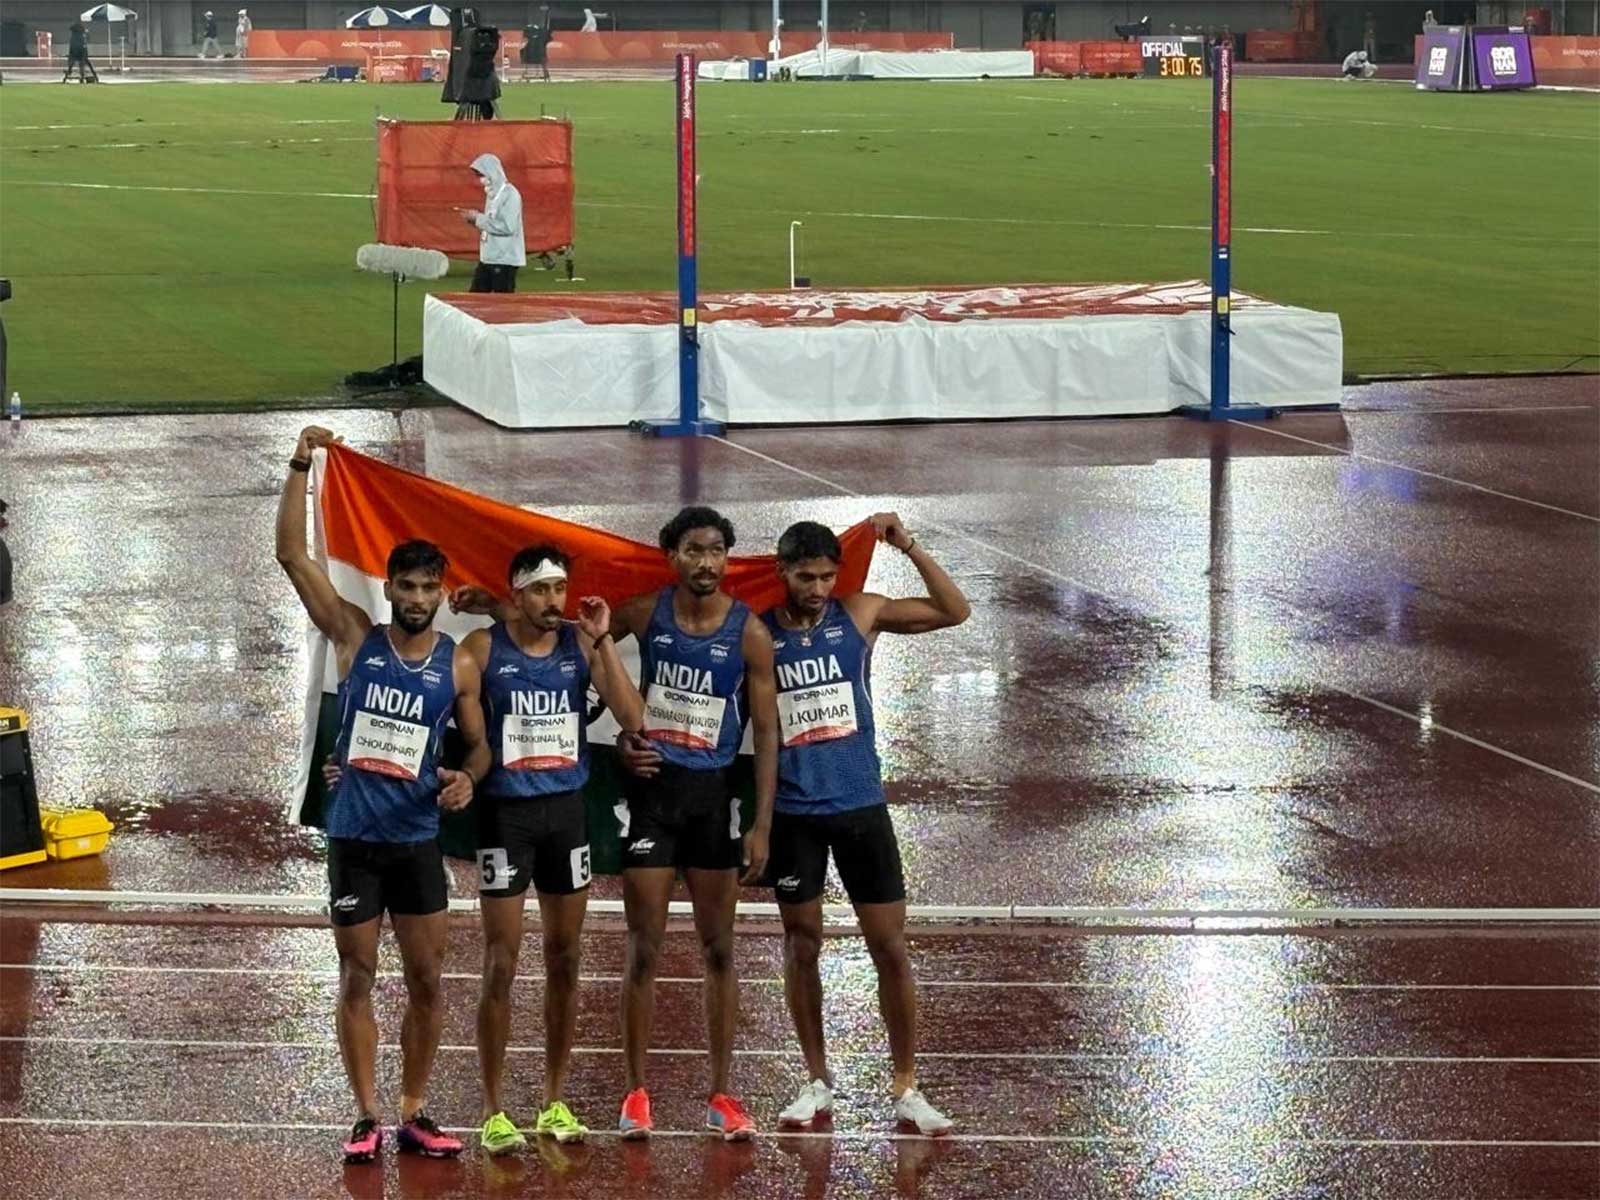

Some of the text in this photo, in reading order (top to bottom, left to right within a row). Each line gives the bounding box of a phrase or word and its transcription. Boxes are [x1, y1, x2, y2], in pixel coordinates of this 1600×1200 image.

[1142, 42, 1187, 57] OFFICIAL
[656, 660, 713, 695] INDIA
[777, 654, 843, 689] INDIA
[364, 682, 424, 720] INDIA
[511, 690, 571, 715] INDIA
[664, 691, 710, 707] BORNAN
[793, 686, 839, 702] BORNAN
[370, 718, 415, 735] BORNAN
[521, 717, 566, 727] BORNAN
[788, 704, 849, 727] J.KUMAR
[356, 736, 418, 758] CHOUDHARY
[482, 854, 496, 884] 5
[580, 851, 590, 881] 5
